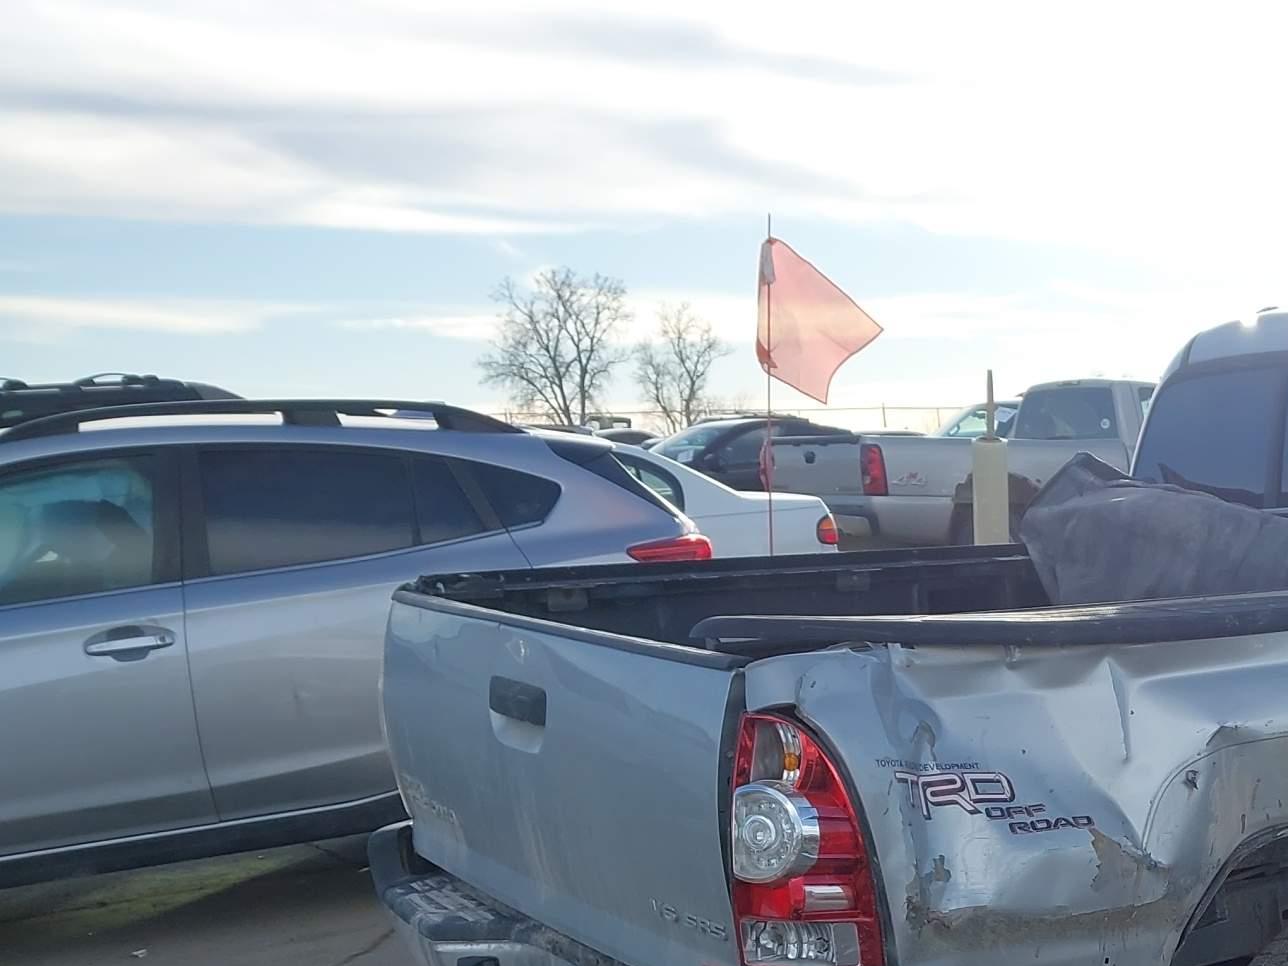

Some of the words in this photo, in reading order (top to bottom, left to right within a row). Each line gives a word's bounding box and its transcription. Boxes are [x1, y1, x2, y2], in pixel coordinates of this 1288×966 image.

[894, 770, 1016, 820] TRD
[984, 803, 1047, 820] OFF
[1008, 815, 1095, 834] ROAD
